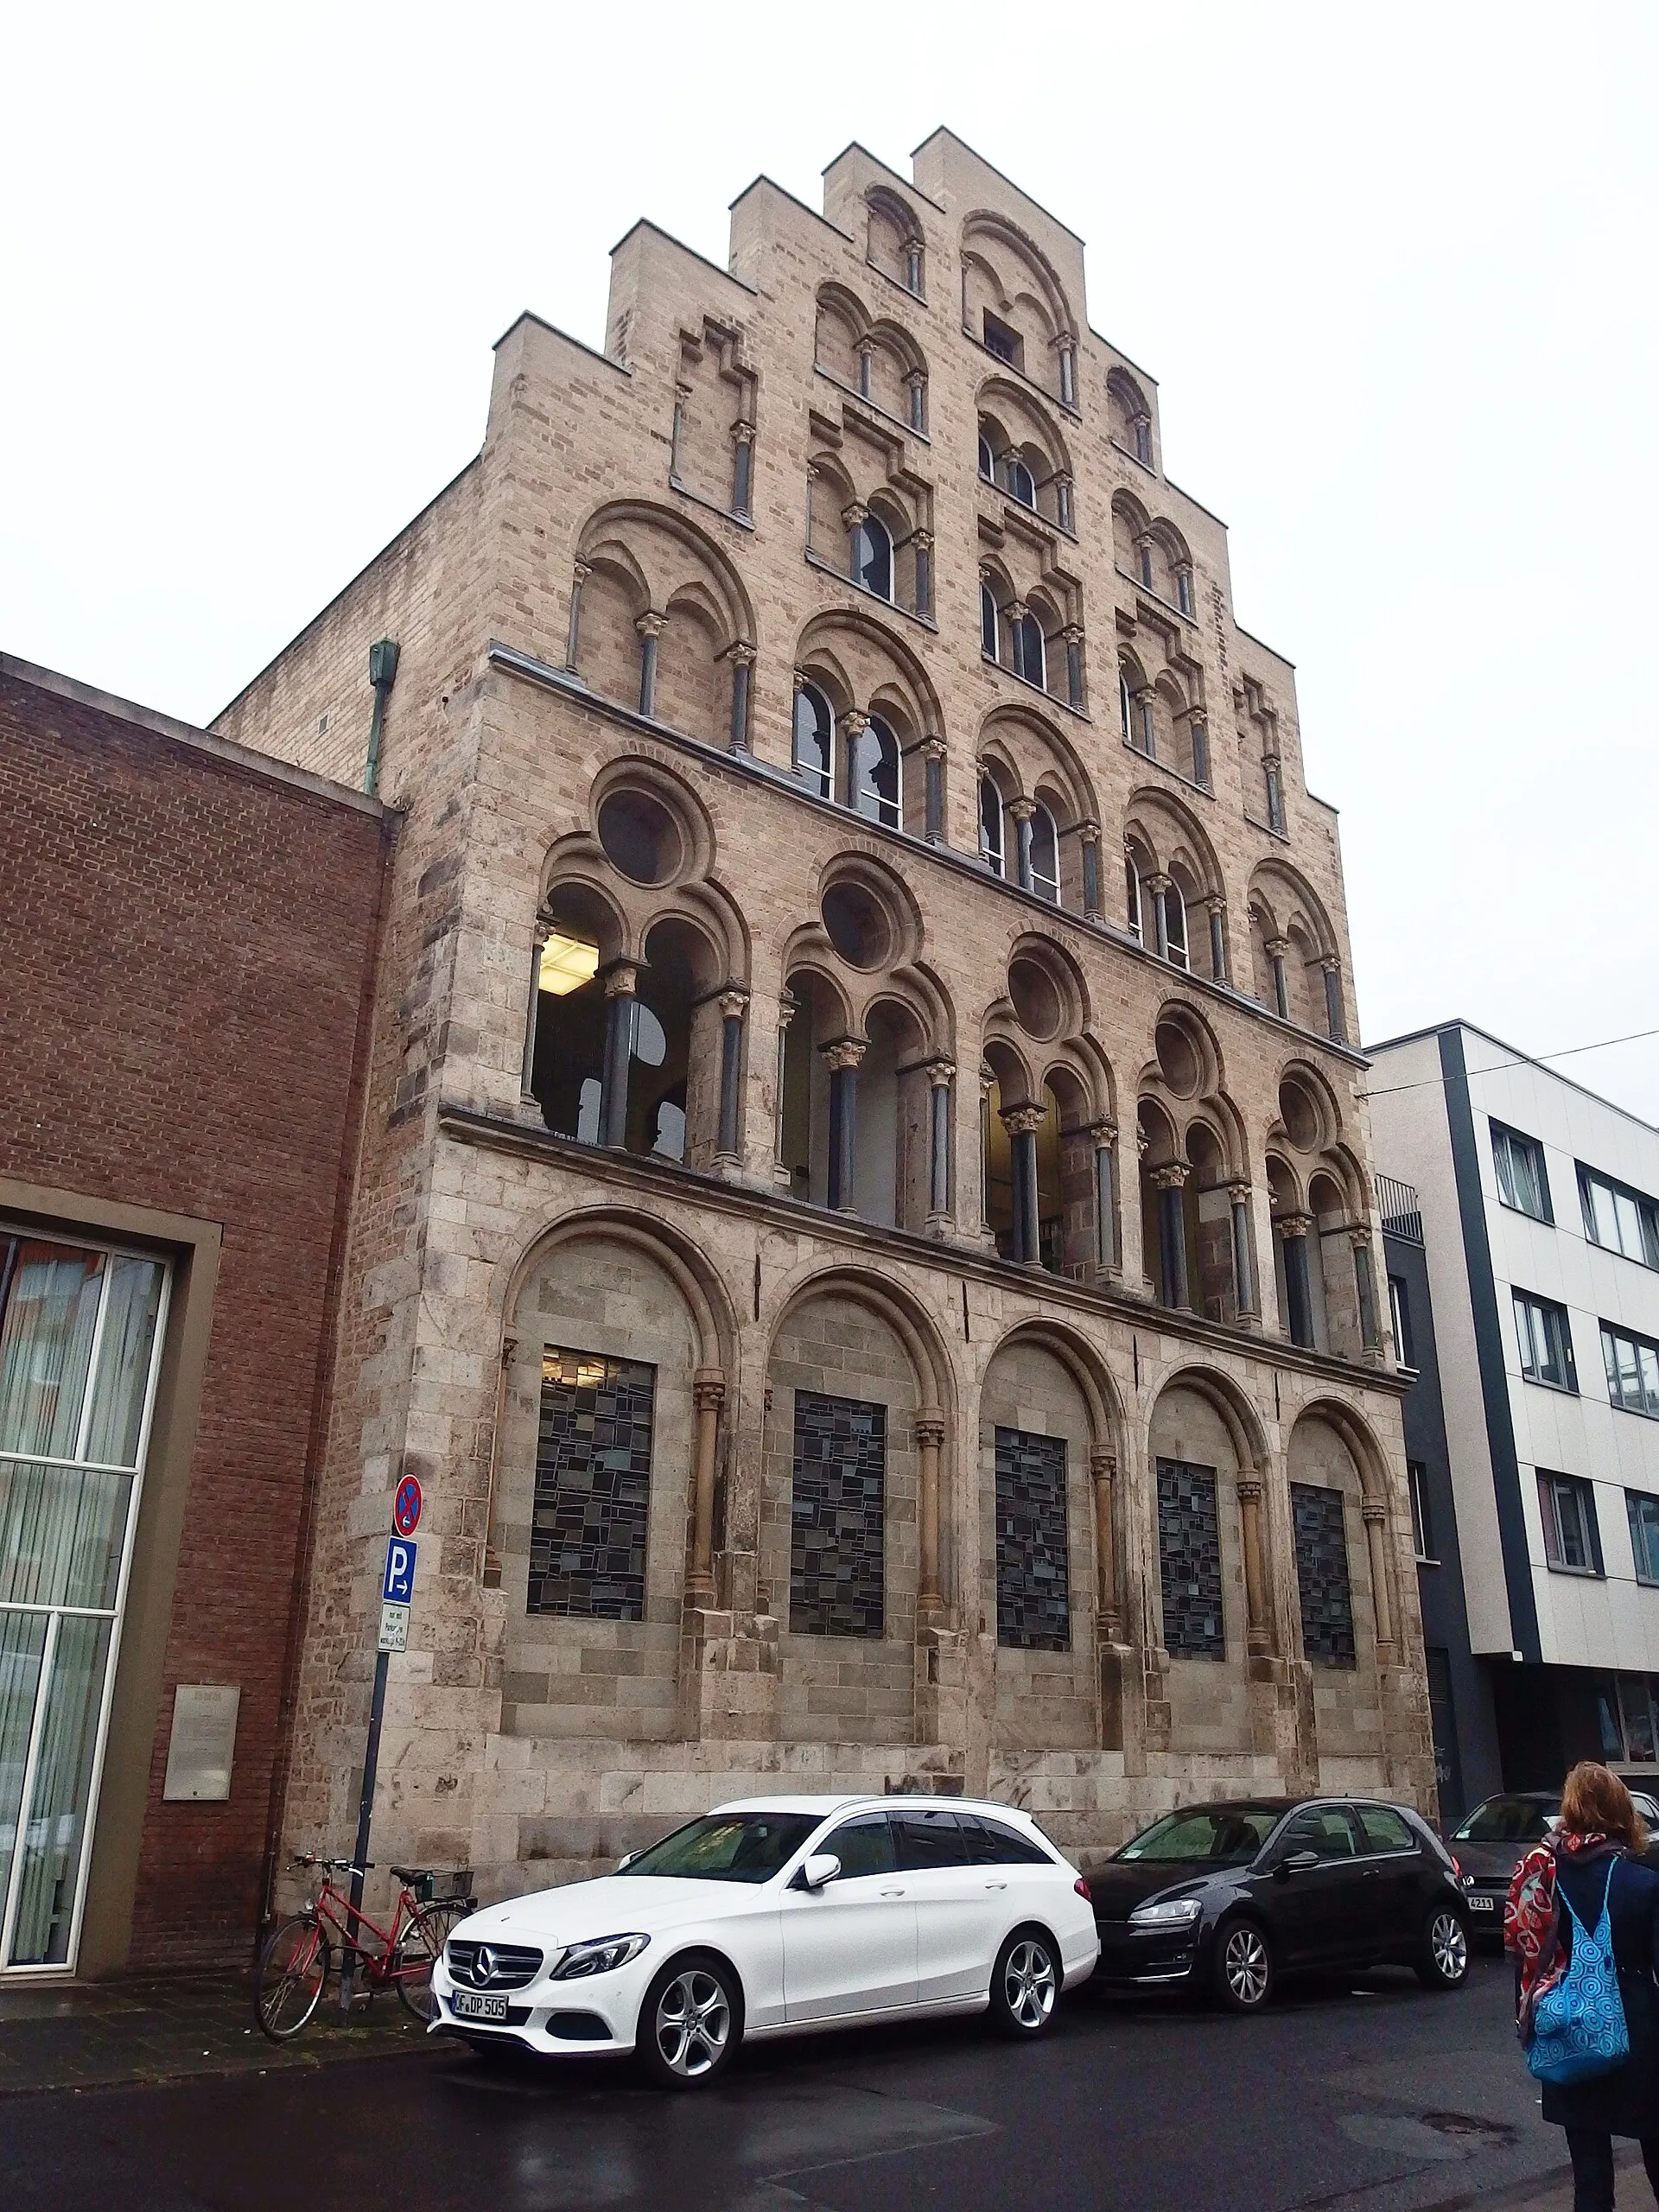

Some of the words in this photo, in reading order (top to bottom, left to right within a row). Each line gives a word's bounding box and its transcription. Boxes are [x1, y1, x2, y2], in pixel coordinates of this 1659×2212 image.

[388, 1546, 408, 1592] P
[1471, 1898, 1492, 1909] 4211
[471, 1997, 483, 2013] DP
[485, 1999, 505, 2016] 505
